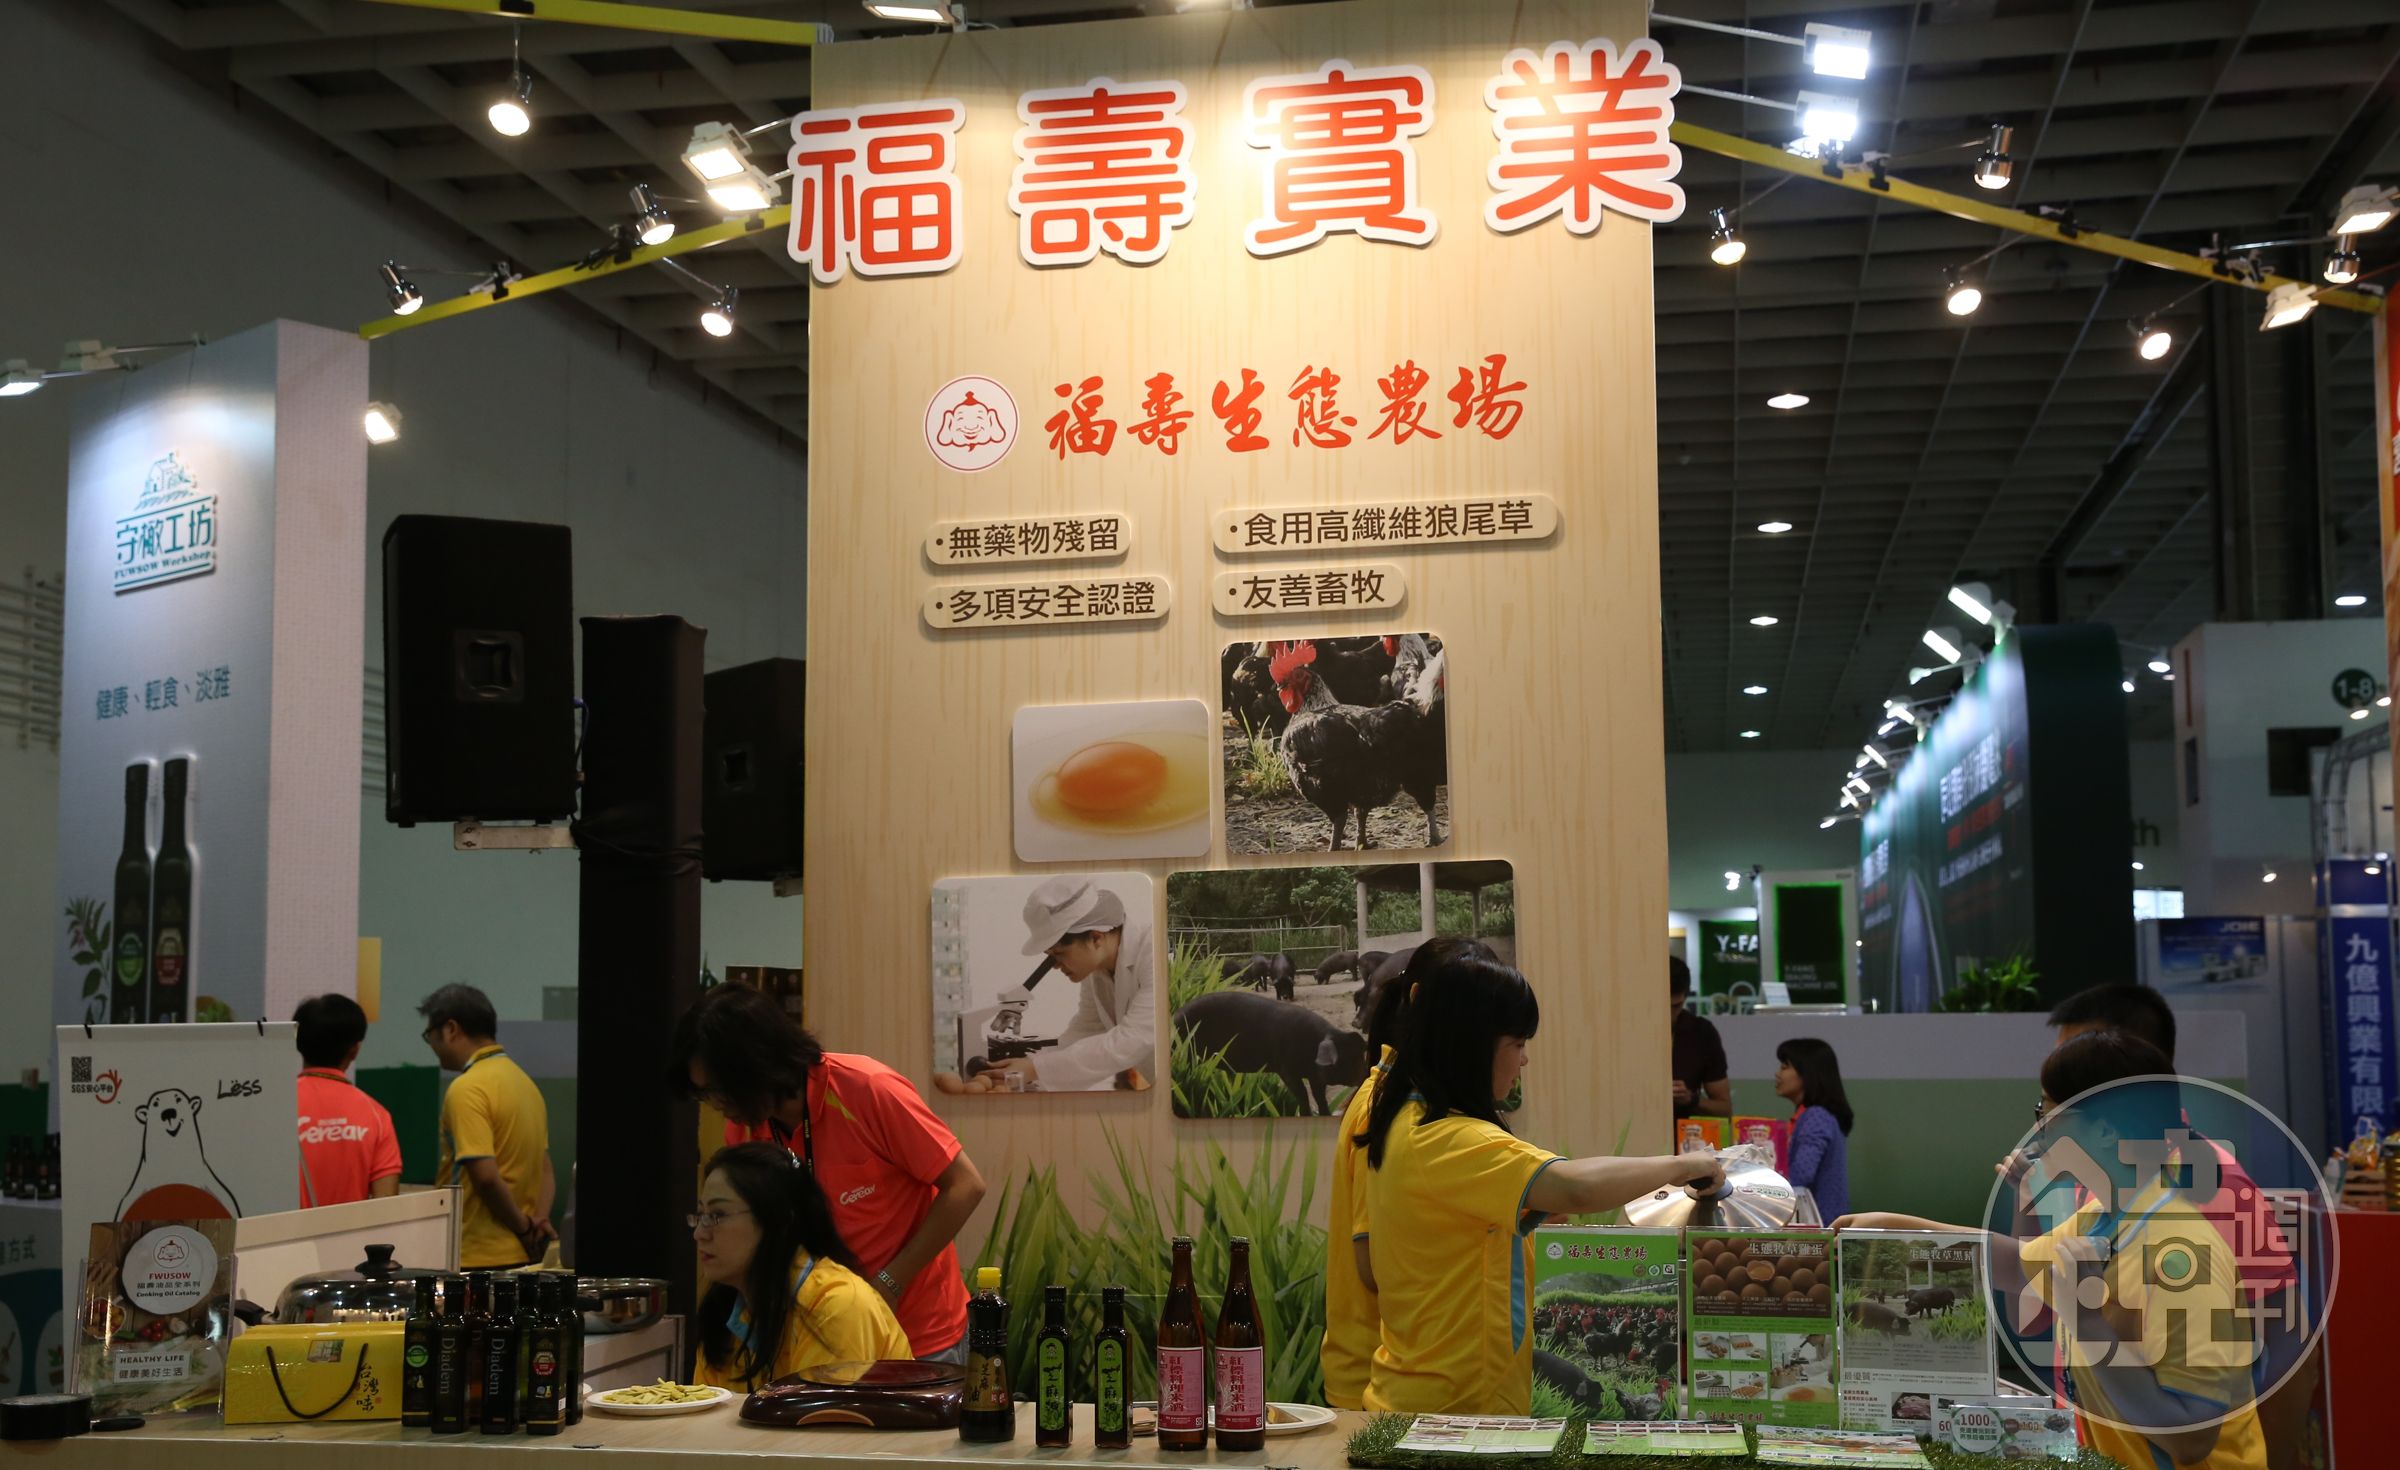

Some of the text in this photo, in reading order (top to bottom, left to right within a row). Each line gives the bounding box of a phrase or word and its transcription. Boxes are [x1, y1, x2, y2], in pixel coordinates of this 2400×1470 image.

[795, 46, 1678, 276] 福壽實業
[1044, 353, 1528, 461] 福壽生態農場
[947, 518, 1120, 558] 無藥物殘留
[1242, 500, 1534, 547] 食用高纖維狼尾草
[947, 581, 1157, 623] 多項安全認證
[1242, 568, 1385, 609] 友善畜牧
[96, 665, 230, 720] 健康、輕食、淡雅
[2337, 678, 2374, 702] 1-8
[1567, 1244, 1648, 1261] 福壽生態農場
[1749, 1242, 1824, 1256] 生態牧草雞蛋
[149, 1272, 192, 1281] FWUSOW
[118, 1366, 184, 1379] 健康美好生活
[120, 1354, 184, 1364] HEALTHY LIFE
[440, 1337, 456, 1394] Diadem
[489, 1338, 505, 1396] Diadem
[1043, 1362, 1063, 1411] 芝麻油
[1102, 1364, 1121, 1413] 芝麻油
[1169, 1355, 1184, 1412] 紅標料理米酒
[1230, 1355, 1245, 1412] 紅標料理米酒
